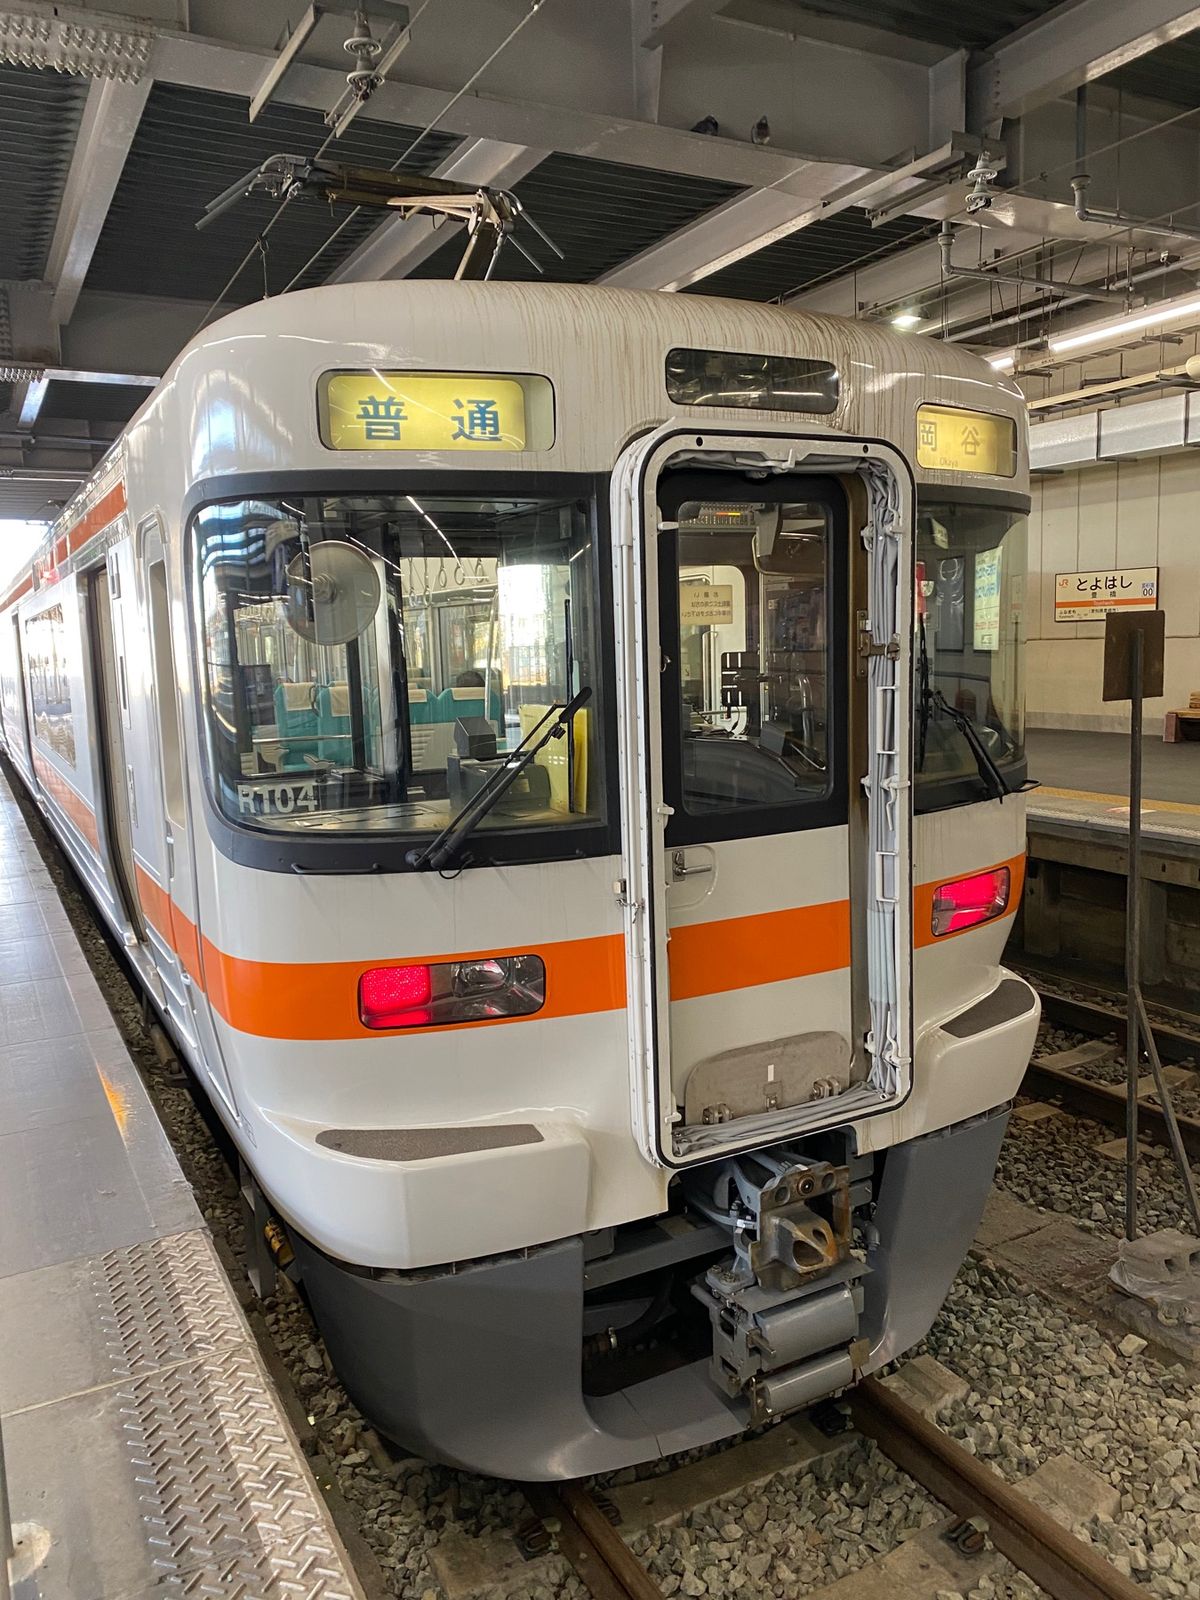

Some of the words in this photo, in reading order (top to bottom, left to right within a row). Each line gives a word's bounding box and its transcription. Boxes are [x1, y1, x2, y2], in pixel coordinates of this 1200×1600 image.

[356, 395, 502, 442] 普通
[918, 420, 981, 456] 岡谷
[1058, 578, 1069, 587] JR
[1076, 575, 1132, 591] とよはし
[237, 784, 318, 814] R104
